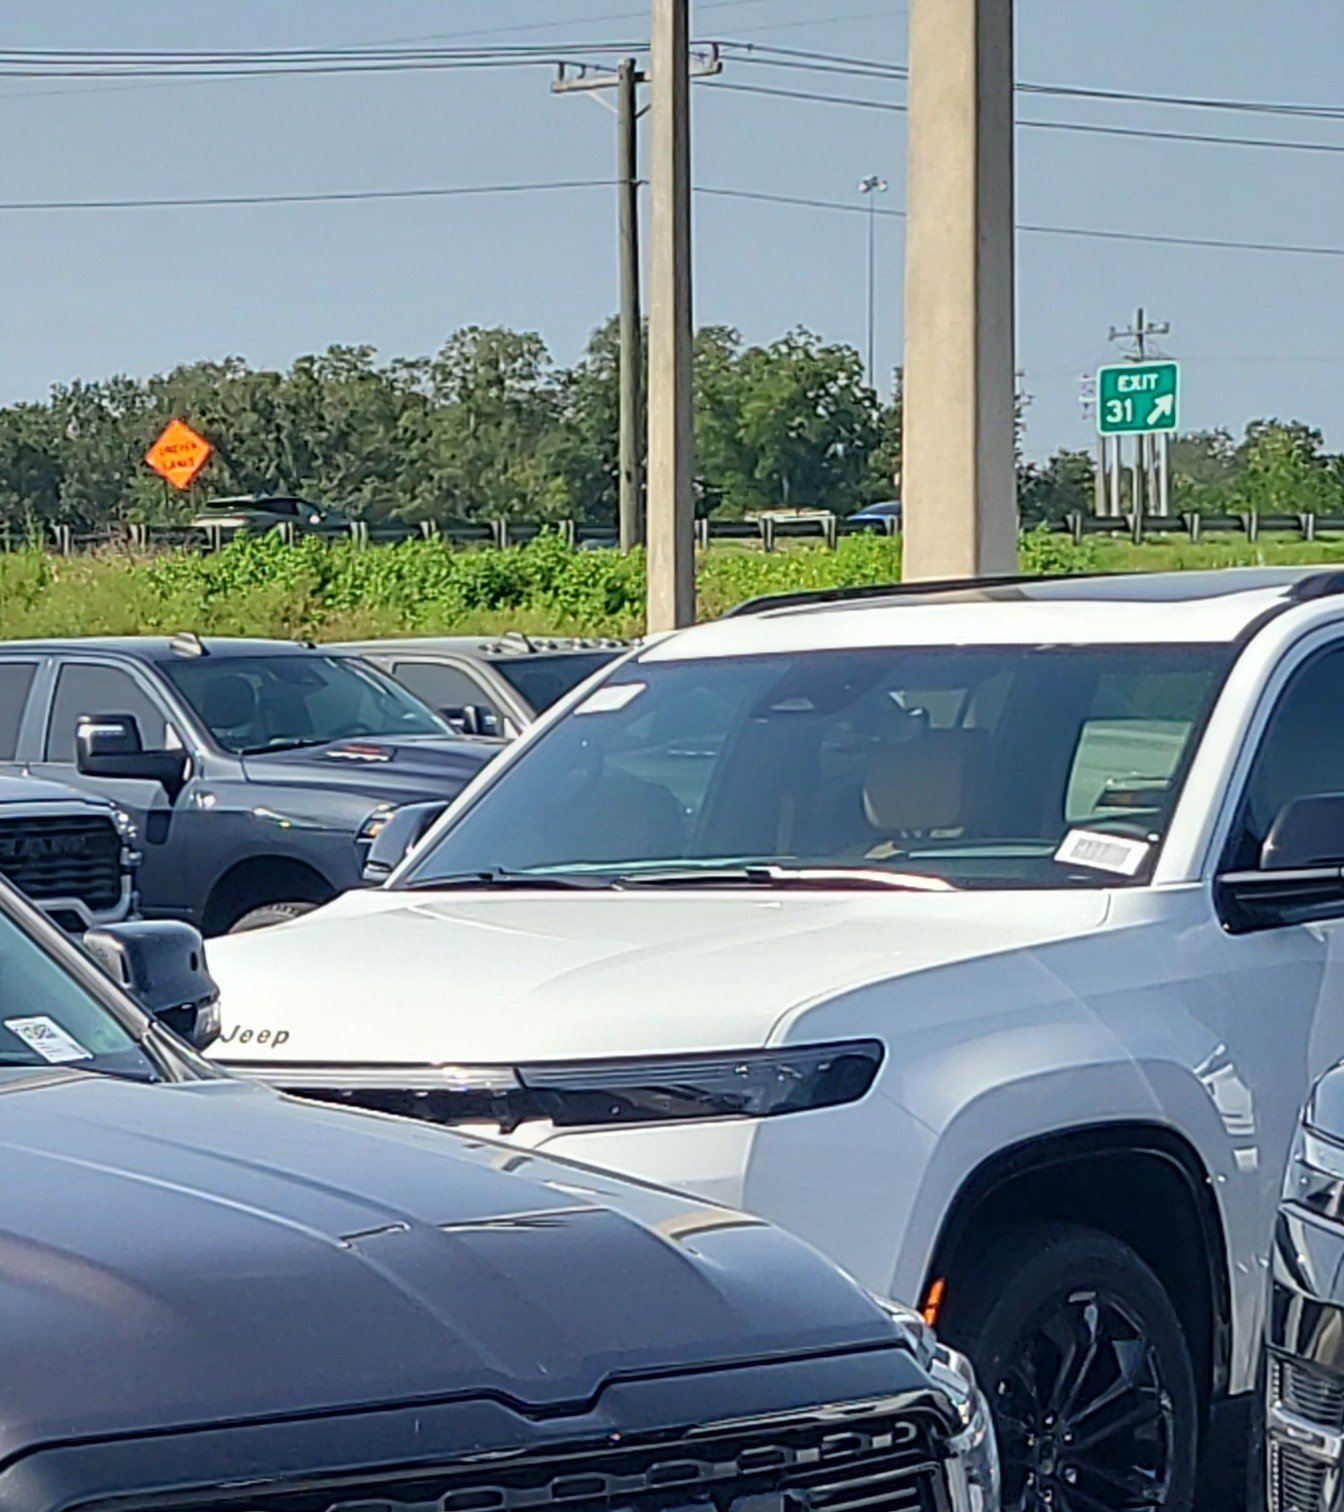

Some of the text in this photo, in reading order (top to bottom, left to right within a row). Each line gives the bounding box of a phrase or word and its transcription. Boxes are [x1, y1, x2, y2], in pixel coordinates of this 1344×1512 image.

[1117, 373, 1159, 393] EXIT
[1106, 398, 1133, 424] 31
[219, 1024, 290, 1049] Jeep
